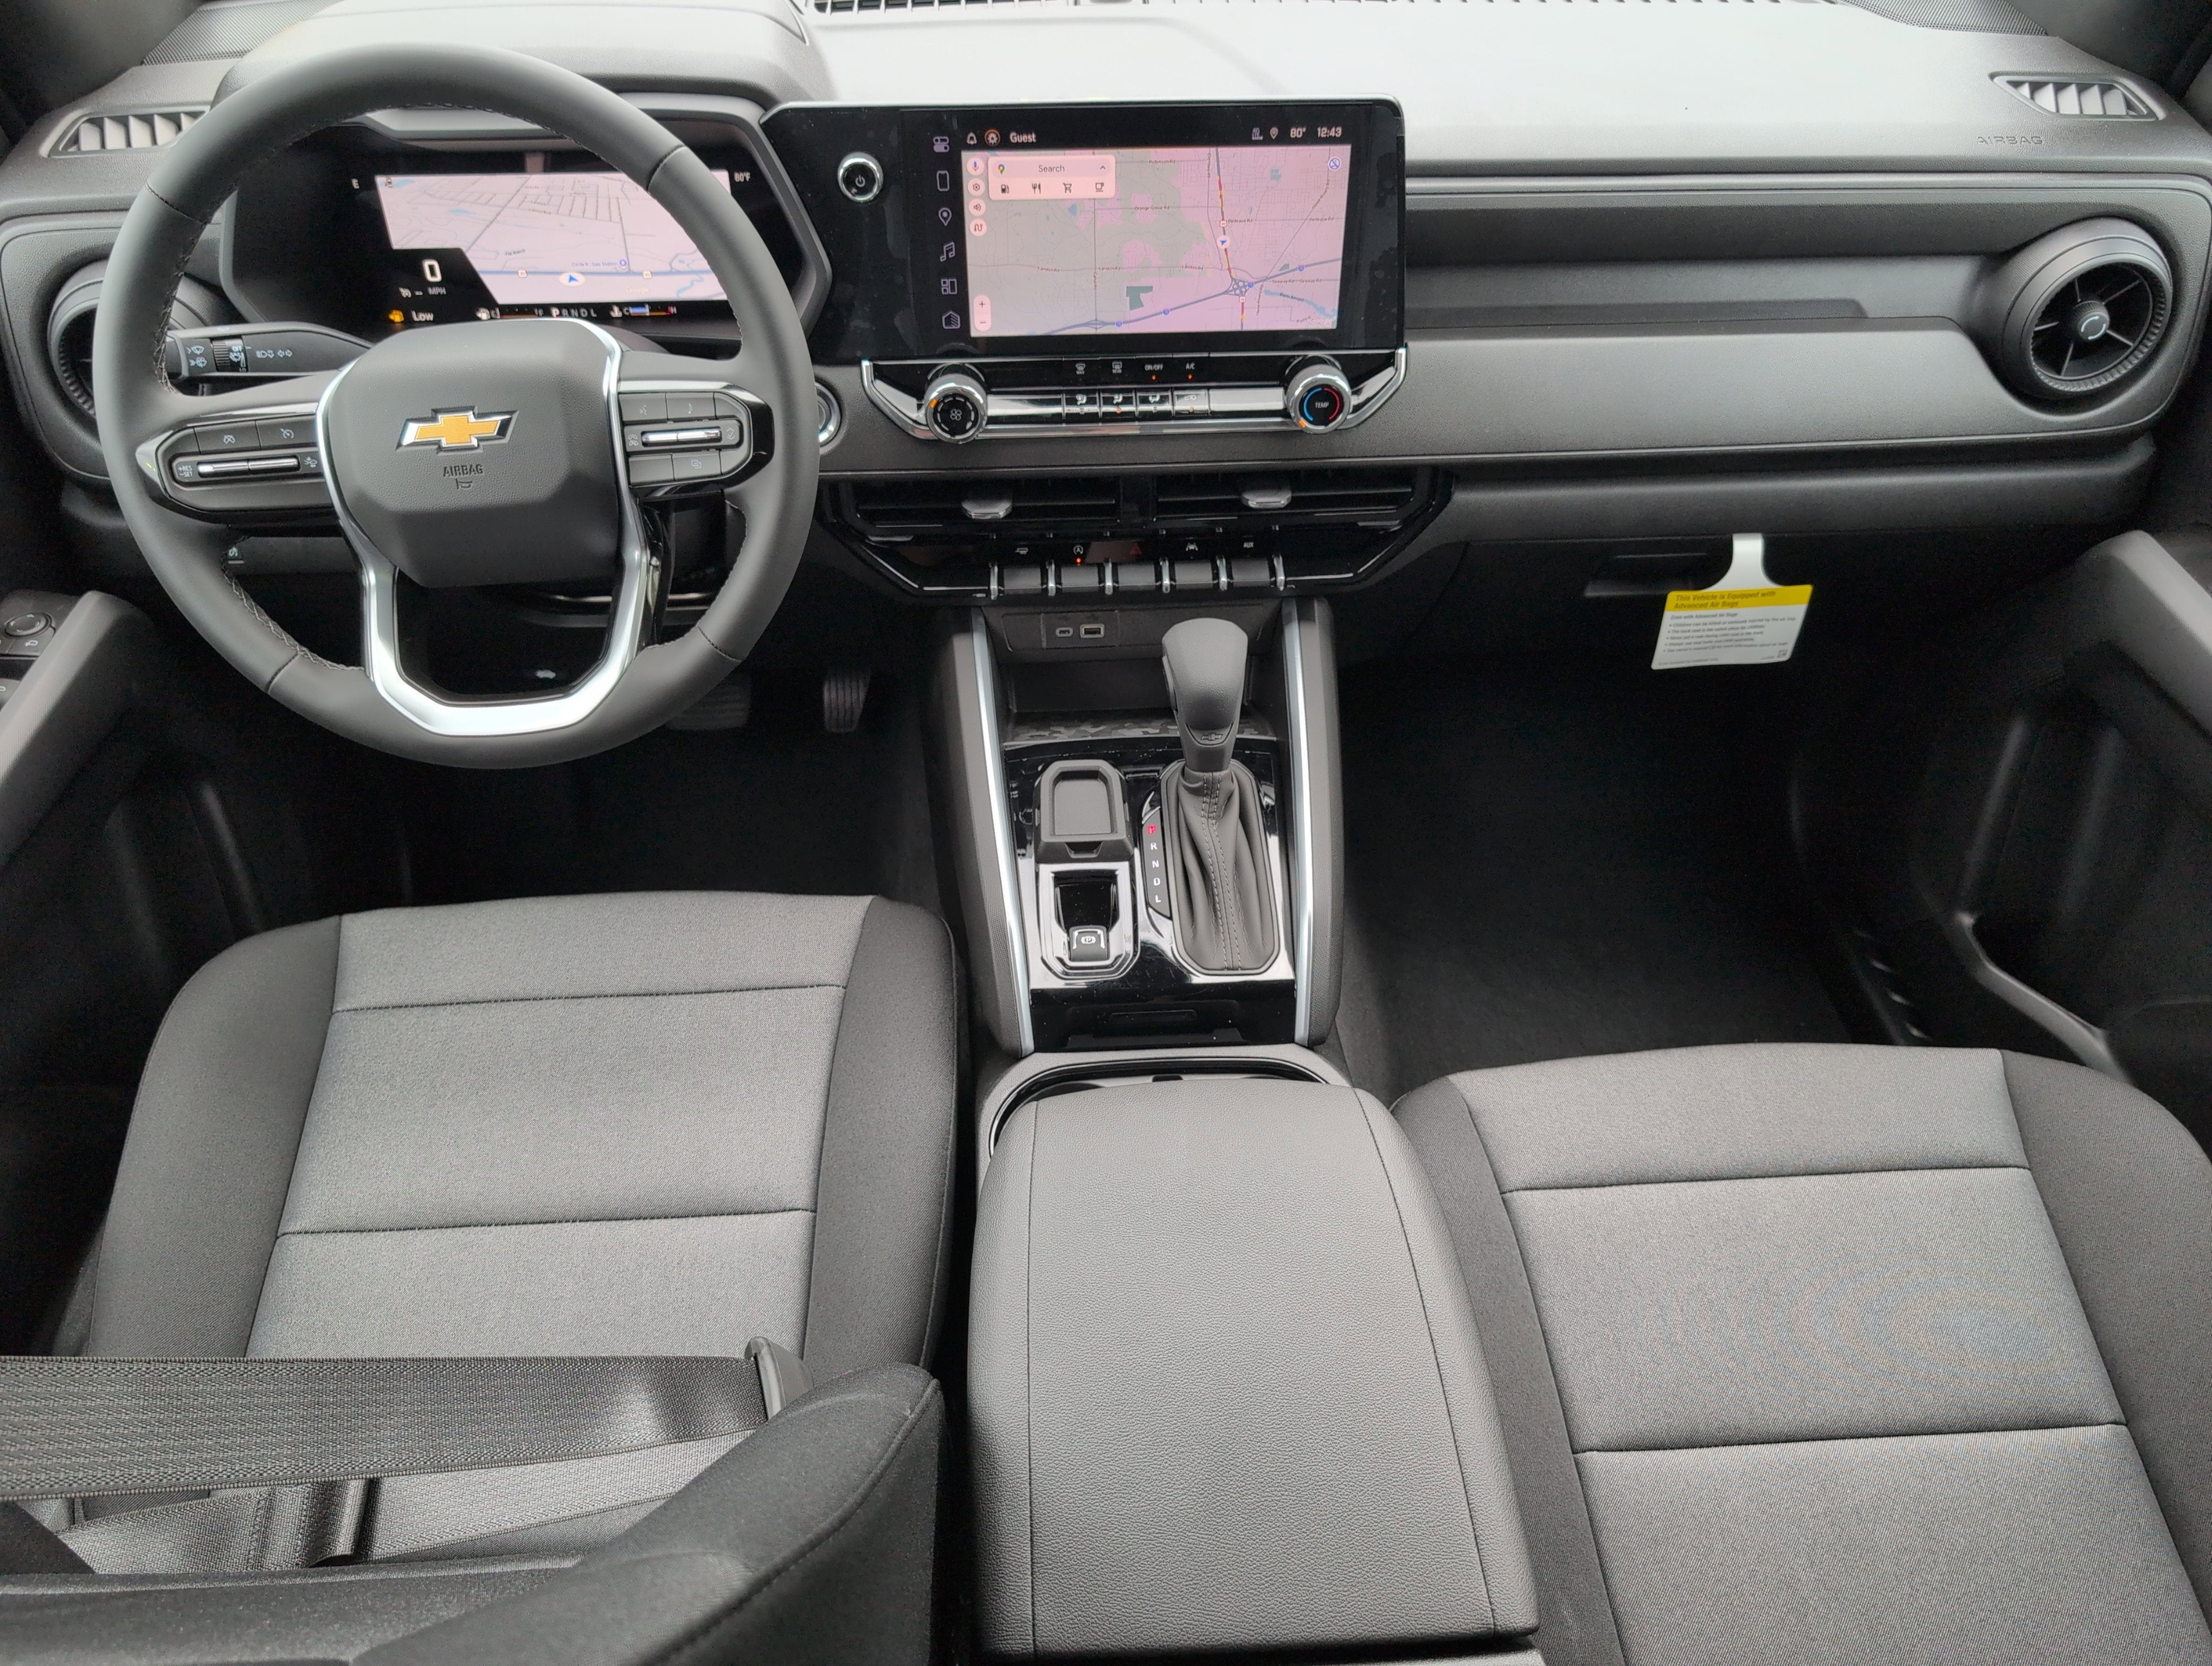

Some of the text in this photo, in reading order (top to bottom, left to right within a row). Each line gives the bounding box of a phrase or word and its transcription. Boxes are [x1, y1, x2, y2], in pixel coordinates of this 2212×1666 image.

[1317, 126, 1342, 138] 12:43
[1009, 132, 1037, 143] Guest
[1977, 136, 2043, 144] AIRBAG
[1038, 164, 1065, 173] Search
[422, 259, 442, 282] 0
[427, 286, 446, 295] MPH
[411, 310, 434, 322] Low
[551, 307, 560, 317] P
[581, 309, 588, 317] D
[590, 308, 597, 317] L
[443, 464, 484, 477] AIRBAG
[1148, 824, 1156, 834] P
[1152, 860, 1159, 868] N
[1153, 877, 1161, 886] D
